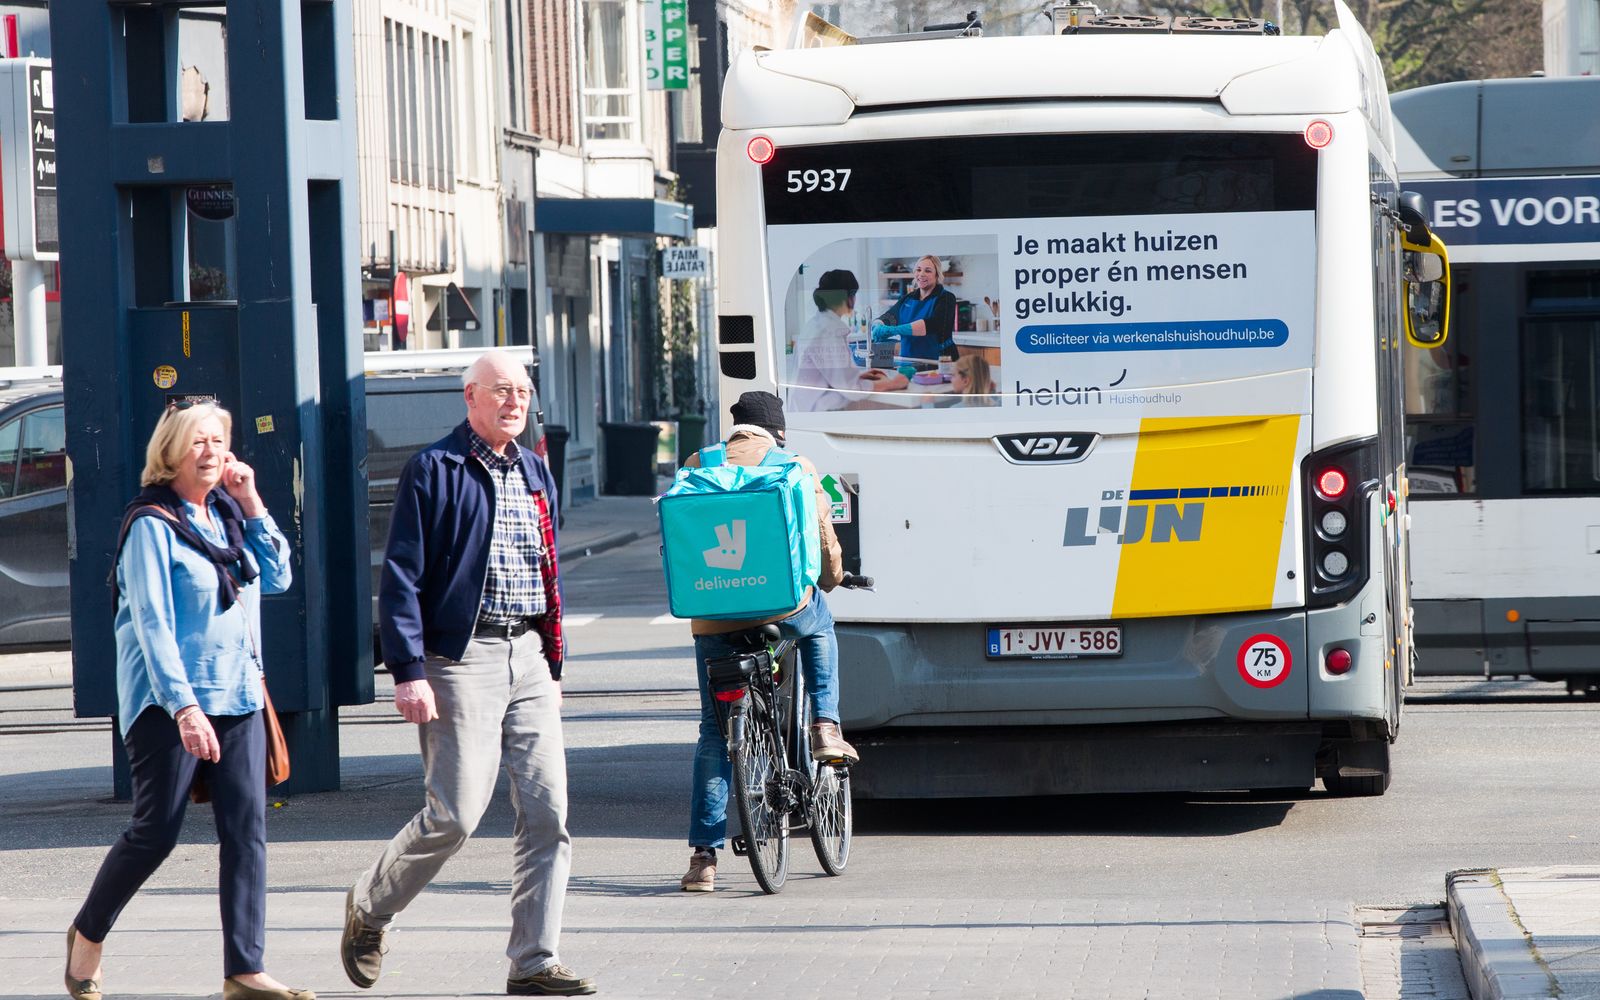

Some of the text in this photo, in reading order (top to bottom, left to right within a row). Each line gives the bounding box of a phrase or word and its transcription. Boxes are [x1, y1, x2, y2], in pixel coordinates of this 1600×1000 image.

[663, 0, 686, 80] PPER
[787, 168, 852, 193] 5937
[188, 189, 233, 200] GUINNES
[1430, 196, 1600, 228] ES VOOR
[1013, 229, 1218, 256] Je maakt huizen
[671, 249, 699, 260] FAIM
[1014, 260, 1247, 290] proper én mensen
[1014, 290, 1133, 320] gelukkig.
[1029, 328, 1275, 347] Solliciteer via werkenalshuishoudhulp.be
[1016, 380, 1102, 406] helan
[1109, 392, 1182, 405] Huishoudhulp
[1010, 437, 1081, 455] VDL
[1101, 489, 1124, 501] DE
[694, 575, 768, 591] deliveroo
[991, 644, 999, 653] B
[1252, 648, 1277, 667] 75
